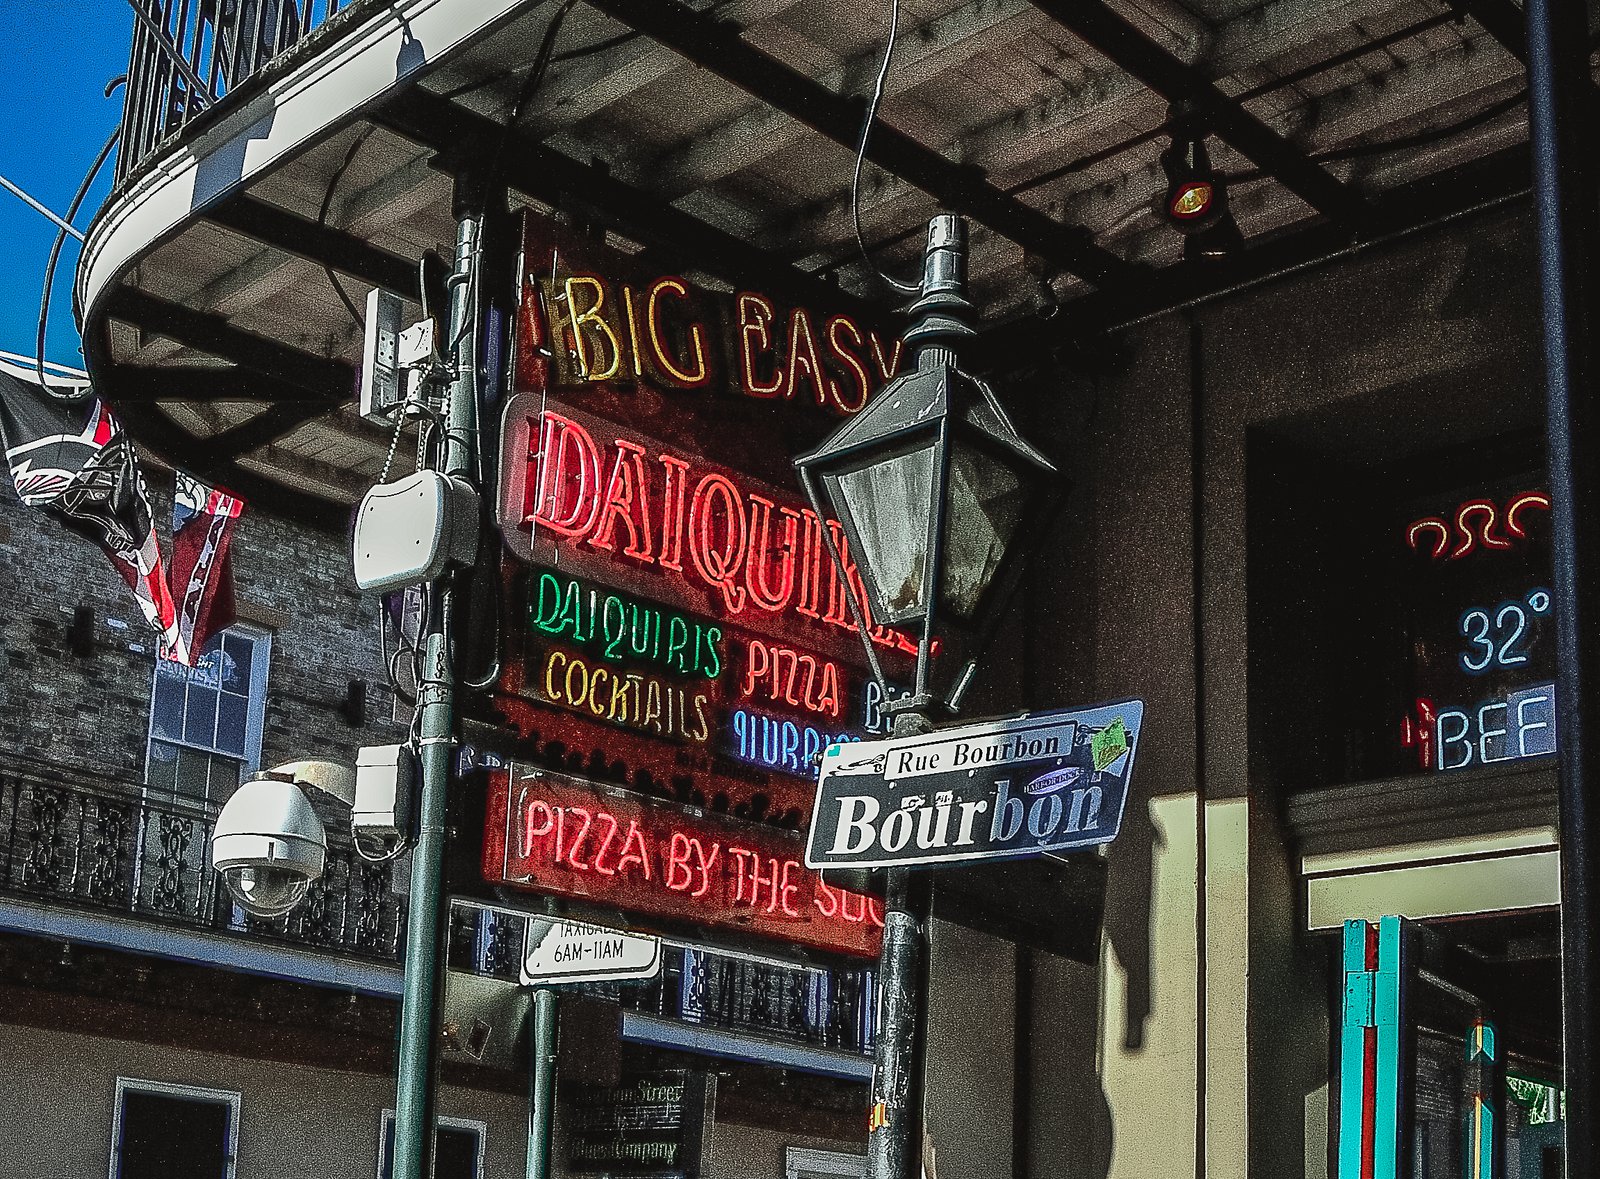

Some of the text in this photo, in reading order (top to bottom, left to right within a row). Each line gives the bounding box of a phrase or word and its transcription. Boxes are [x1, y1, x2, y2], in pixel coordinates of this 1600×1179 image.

[563, 275, 705, 384] BIG
[524, 410, 942, 656] DAIQUIR
[533, 573, 723, 679] DAIQUIRIS
[545, 651, 709, 742] COCKTAILS
[743, 639, 840, 717] PIZZA
[897, 735, 1059, 774] Rue Bourbon
[523, 799, 651, 880] PIZZA
[665, 832, 720, 898] BY
[728, 845, 800, 918] THE
[825, 779, 1103, 856] Bourbon
[554, 938, 625, 963] 6AM-11AM
[637, 1079, 684, 1103] Street
